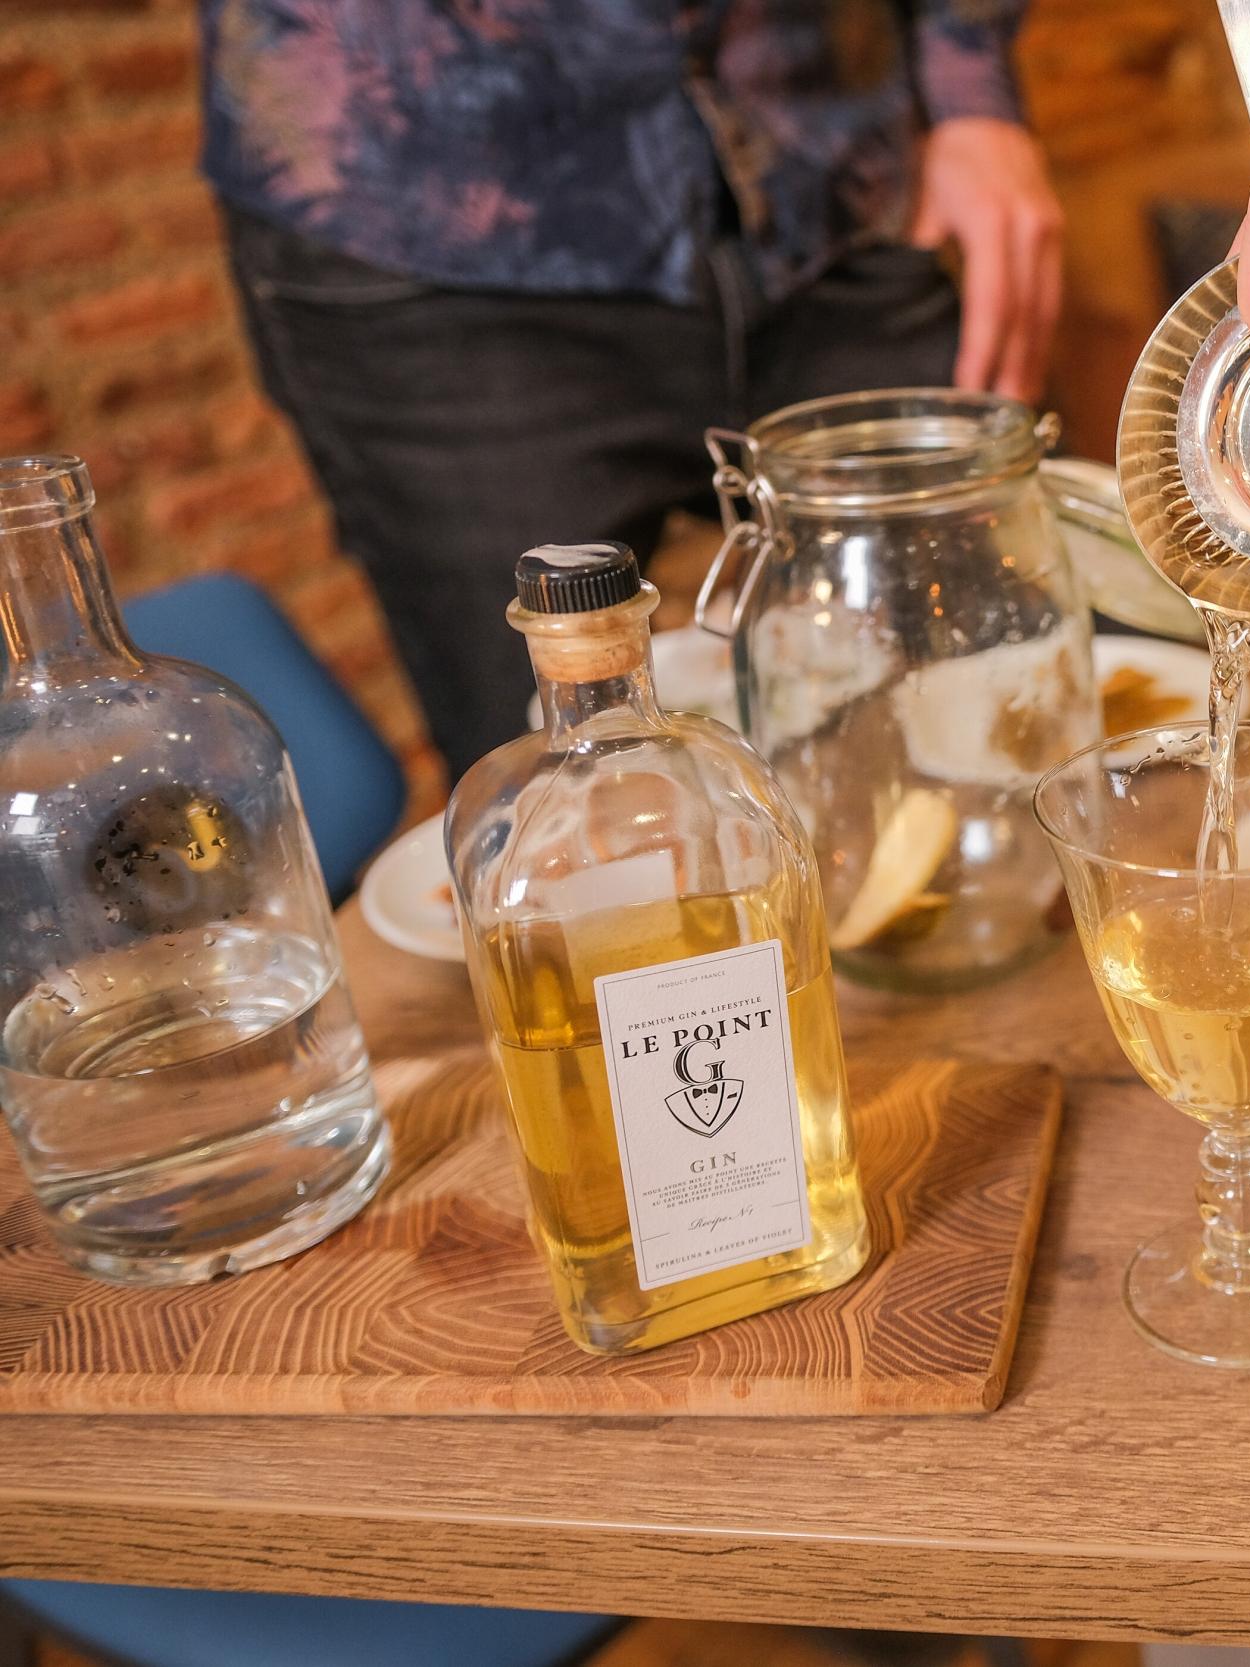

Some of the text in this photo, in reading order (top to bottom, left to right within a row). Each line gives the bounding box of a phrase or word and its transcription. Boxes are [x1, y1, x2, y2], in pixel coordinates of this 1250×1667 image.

[701, 970, 726, 980] FRANCE
[628, 1016, 675, 1031] PREMIUM
[678, 1010, 697, 1020] GIN
[711, 996, 762, 1014] LIFESTYLE
[620, 1009, 772, 1059] LE POINT
[673, 1037, 726, 1086] G
[690, 1151, 736, 1173] GIN
